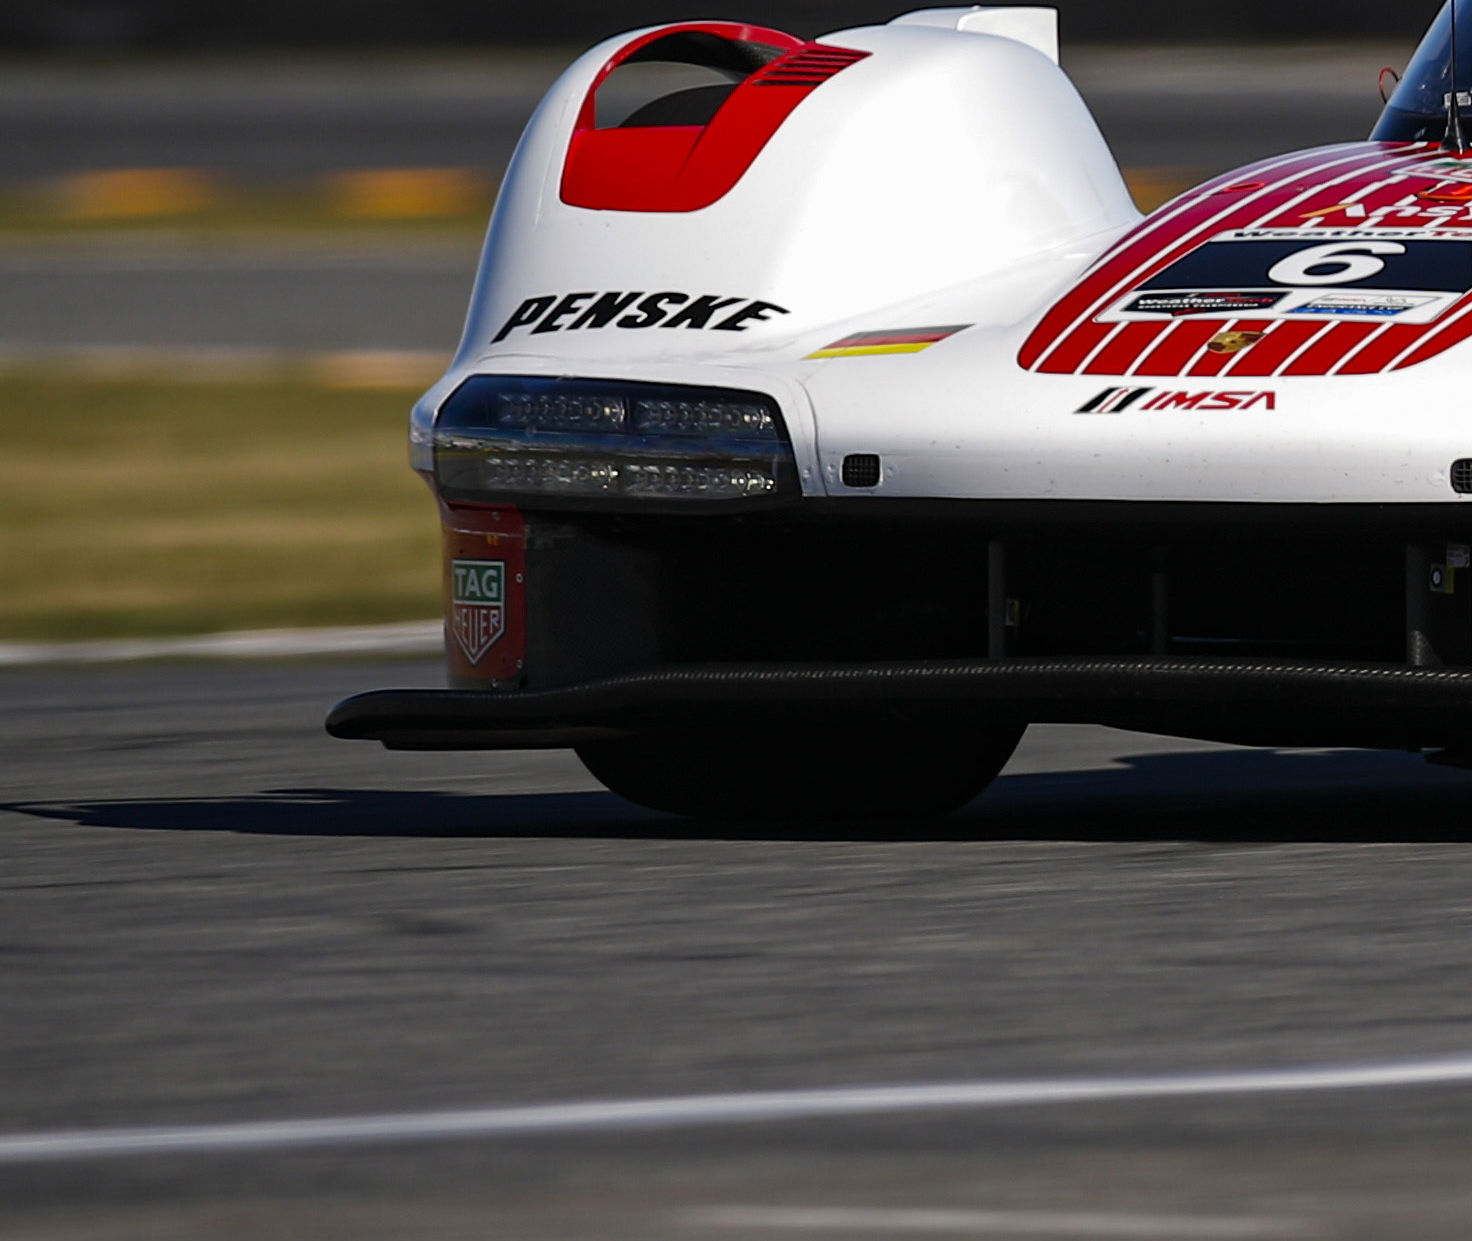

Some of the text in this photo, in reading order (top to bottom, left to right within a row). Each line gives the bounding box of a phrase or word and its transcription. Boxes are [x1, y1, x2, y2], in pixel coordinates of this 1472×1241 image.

[1267, 241, 1406, 286] 6
[490, 291, 791, 344] PENSKE
[454, 568, 498, 598] TAG
[453, 608, 501, 655] HEUER
